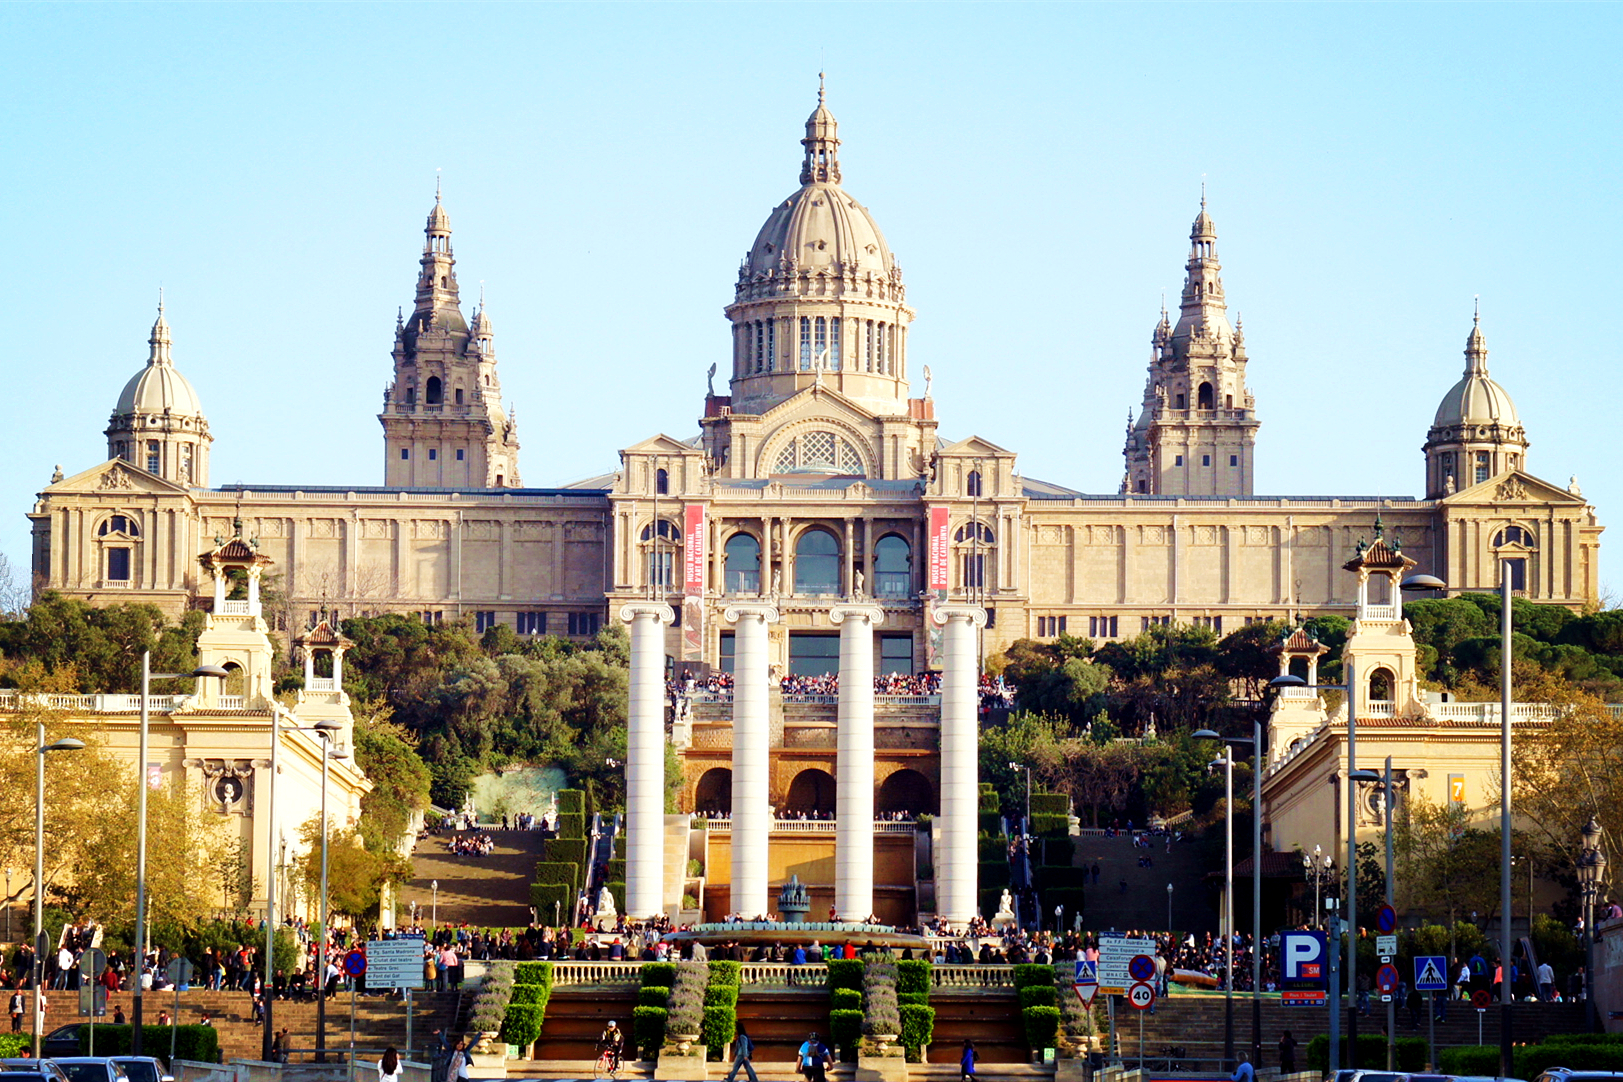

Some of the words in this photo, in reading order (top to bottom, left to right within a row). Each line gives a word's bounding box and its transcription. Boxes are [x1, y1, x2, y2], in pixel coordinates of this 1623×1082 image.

[695, 556, 702, 564] DE
[940, 558, 947, 566] DE
[1454, 782, 1462, 796] 7
[1286, 935, 1321, 978] P
[1134, 991, 1150, 1000] 40
